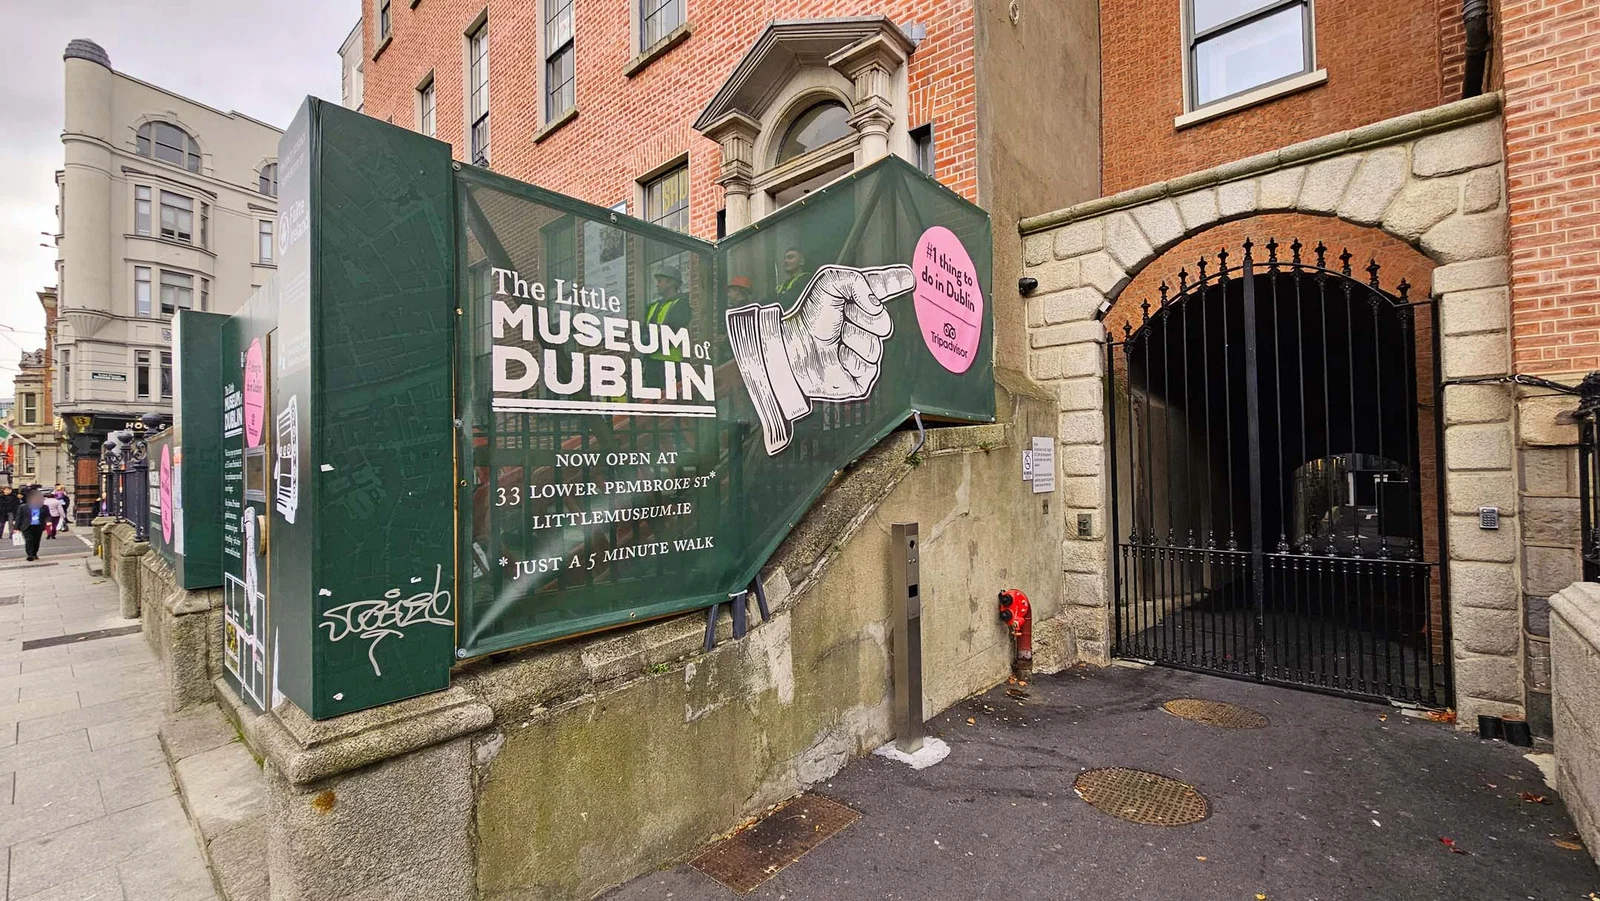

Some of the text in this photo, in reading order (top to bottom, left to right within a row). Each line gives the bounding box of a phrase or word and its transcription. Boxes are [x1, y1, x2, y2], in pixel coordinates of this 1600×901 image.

[926, 242, 973, 287] #1 thing to
[491, 267, 546, 301] The
[554, 278, 621, 313] Little
[921, 265, 975, 312] do in Dublin
[492, 299, 711, 361] MUSEUM of
[930, 331, 968, 359] Tripadvisor
[492, 344, 716, 402] DUBLIN
[125, 422, 166, 430] HOE
[555, 452, 678, 468] NOW OPEN AT
[495, 486, 521, 507] 33
[530, 482, 599, 499] LOWER
[604, 477, 691, 495] PEMBROKE
[532, 502, 692, 530] LITTLEMUSEUM.IE
[513, 556, 563, 581] JUST
[568, 554, 582, 569] A
[586, 552, 597, 571] 5
[602, 541, 669, 563] MINUTE
[673, 536, 715, 553] WALK
